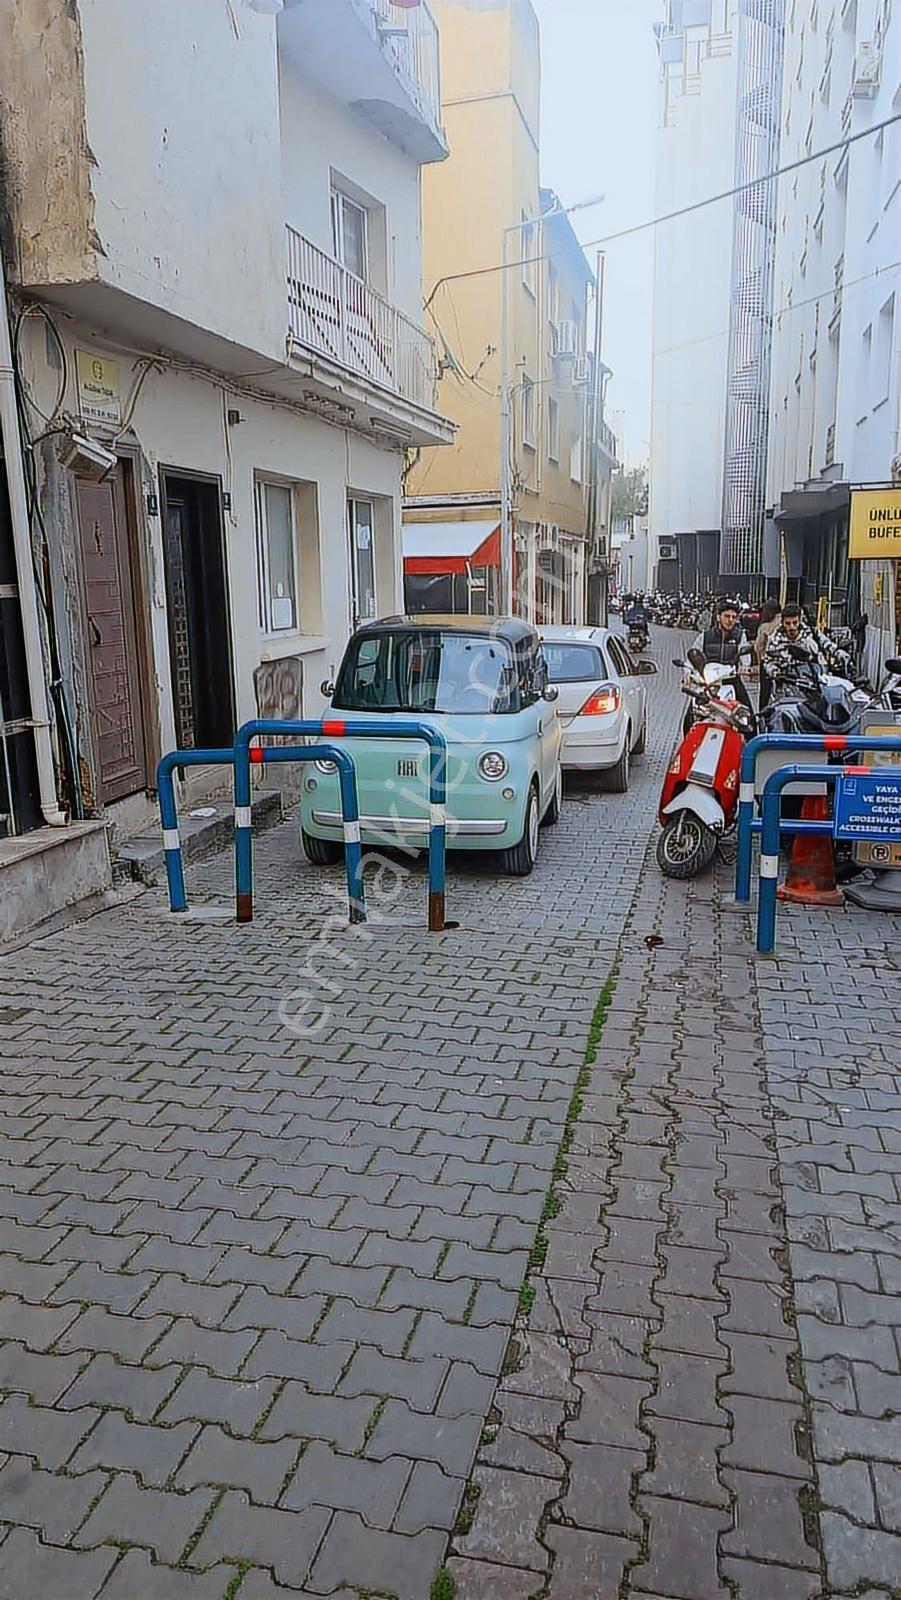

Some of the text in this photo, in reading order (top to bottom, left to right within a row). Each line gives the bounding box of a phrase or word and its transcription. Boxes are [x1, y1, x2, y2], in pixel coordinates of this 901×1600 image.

[875, 785, 899, 793] YAYA
[863, 795, 875, 803] VE
[849, 815, 901, 824] CROSSWALK
[839, 824, 889, 833] ACCESSIBLE
